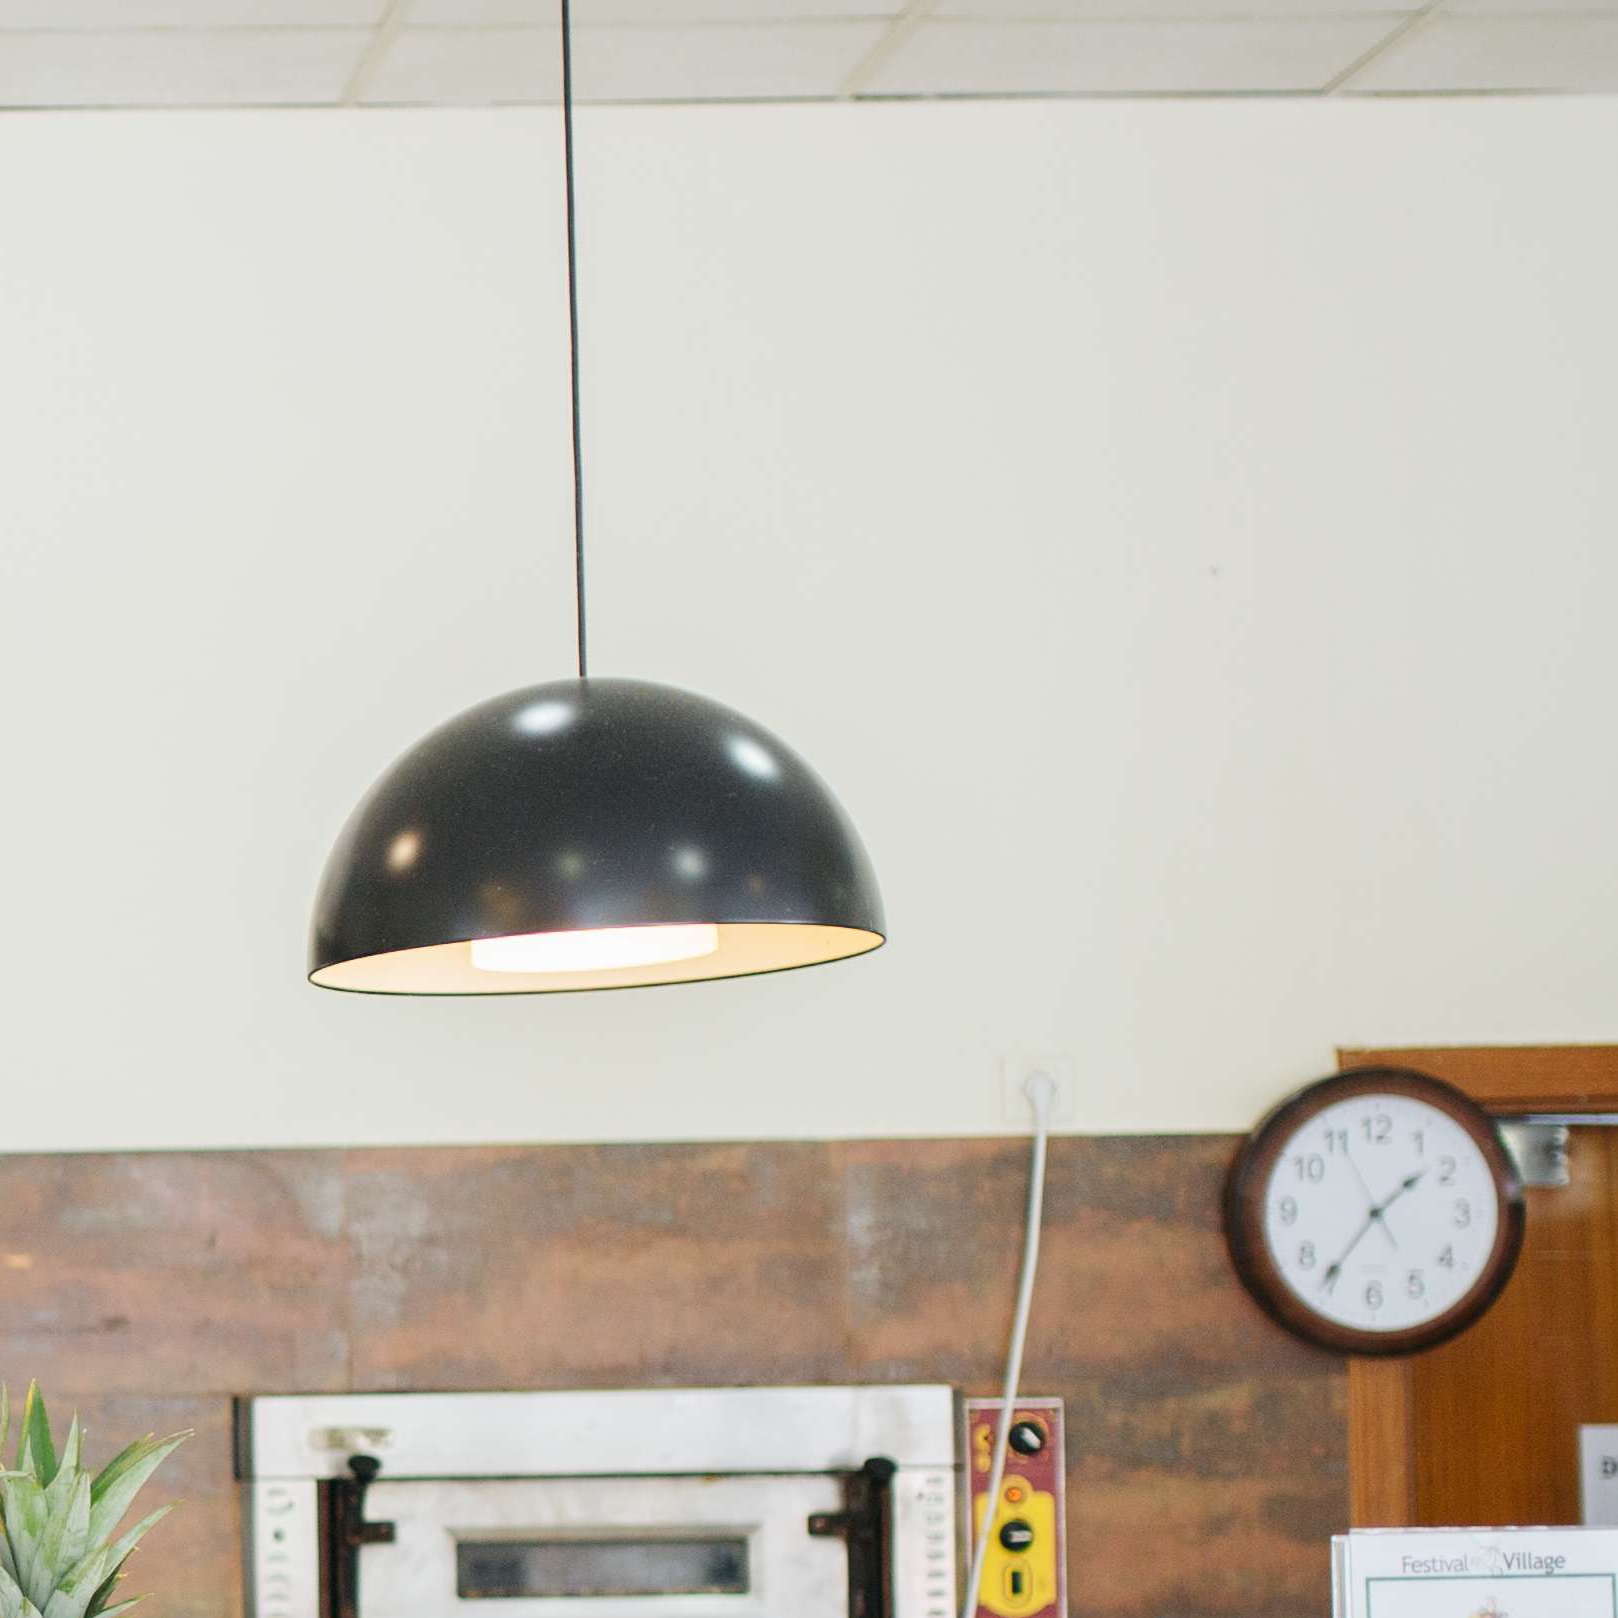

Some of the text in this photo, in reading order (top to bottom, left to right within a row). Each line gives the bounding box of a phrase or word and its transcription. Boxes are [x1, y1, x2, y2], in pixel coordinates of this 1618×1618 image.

[1324, 1129, 1349, 1156] 11
[1362, 1114, 1392, 1145] 12
[1413, 1130, 1424, 1155] 1
[1293, 1153, 1325, 1184] 10
[1438, 1156, 1456, 1185] 2
[1278, 1196, 1298, 1226] 9
[1454, 1199, 1471, 1228] 3
[1297, 1241, 1316, 1270] 8
[1438, 1245, 1454, 1271] 4
[1364, 1280, 1383, 1310] 6
[1406, 1270, 1425, 1299] 5
[1401, 1552, 1566, 1576] Festival Village
